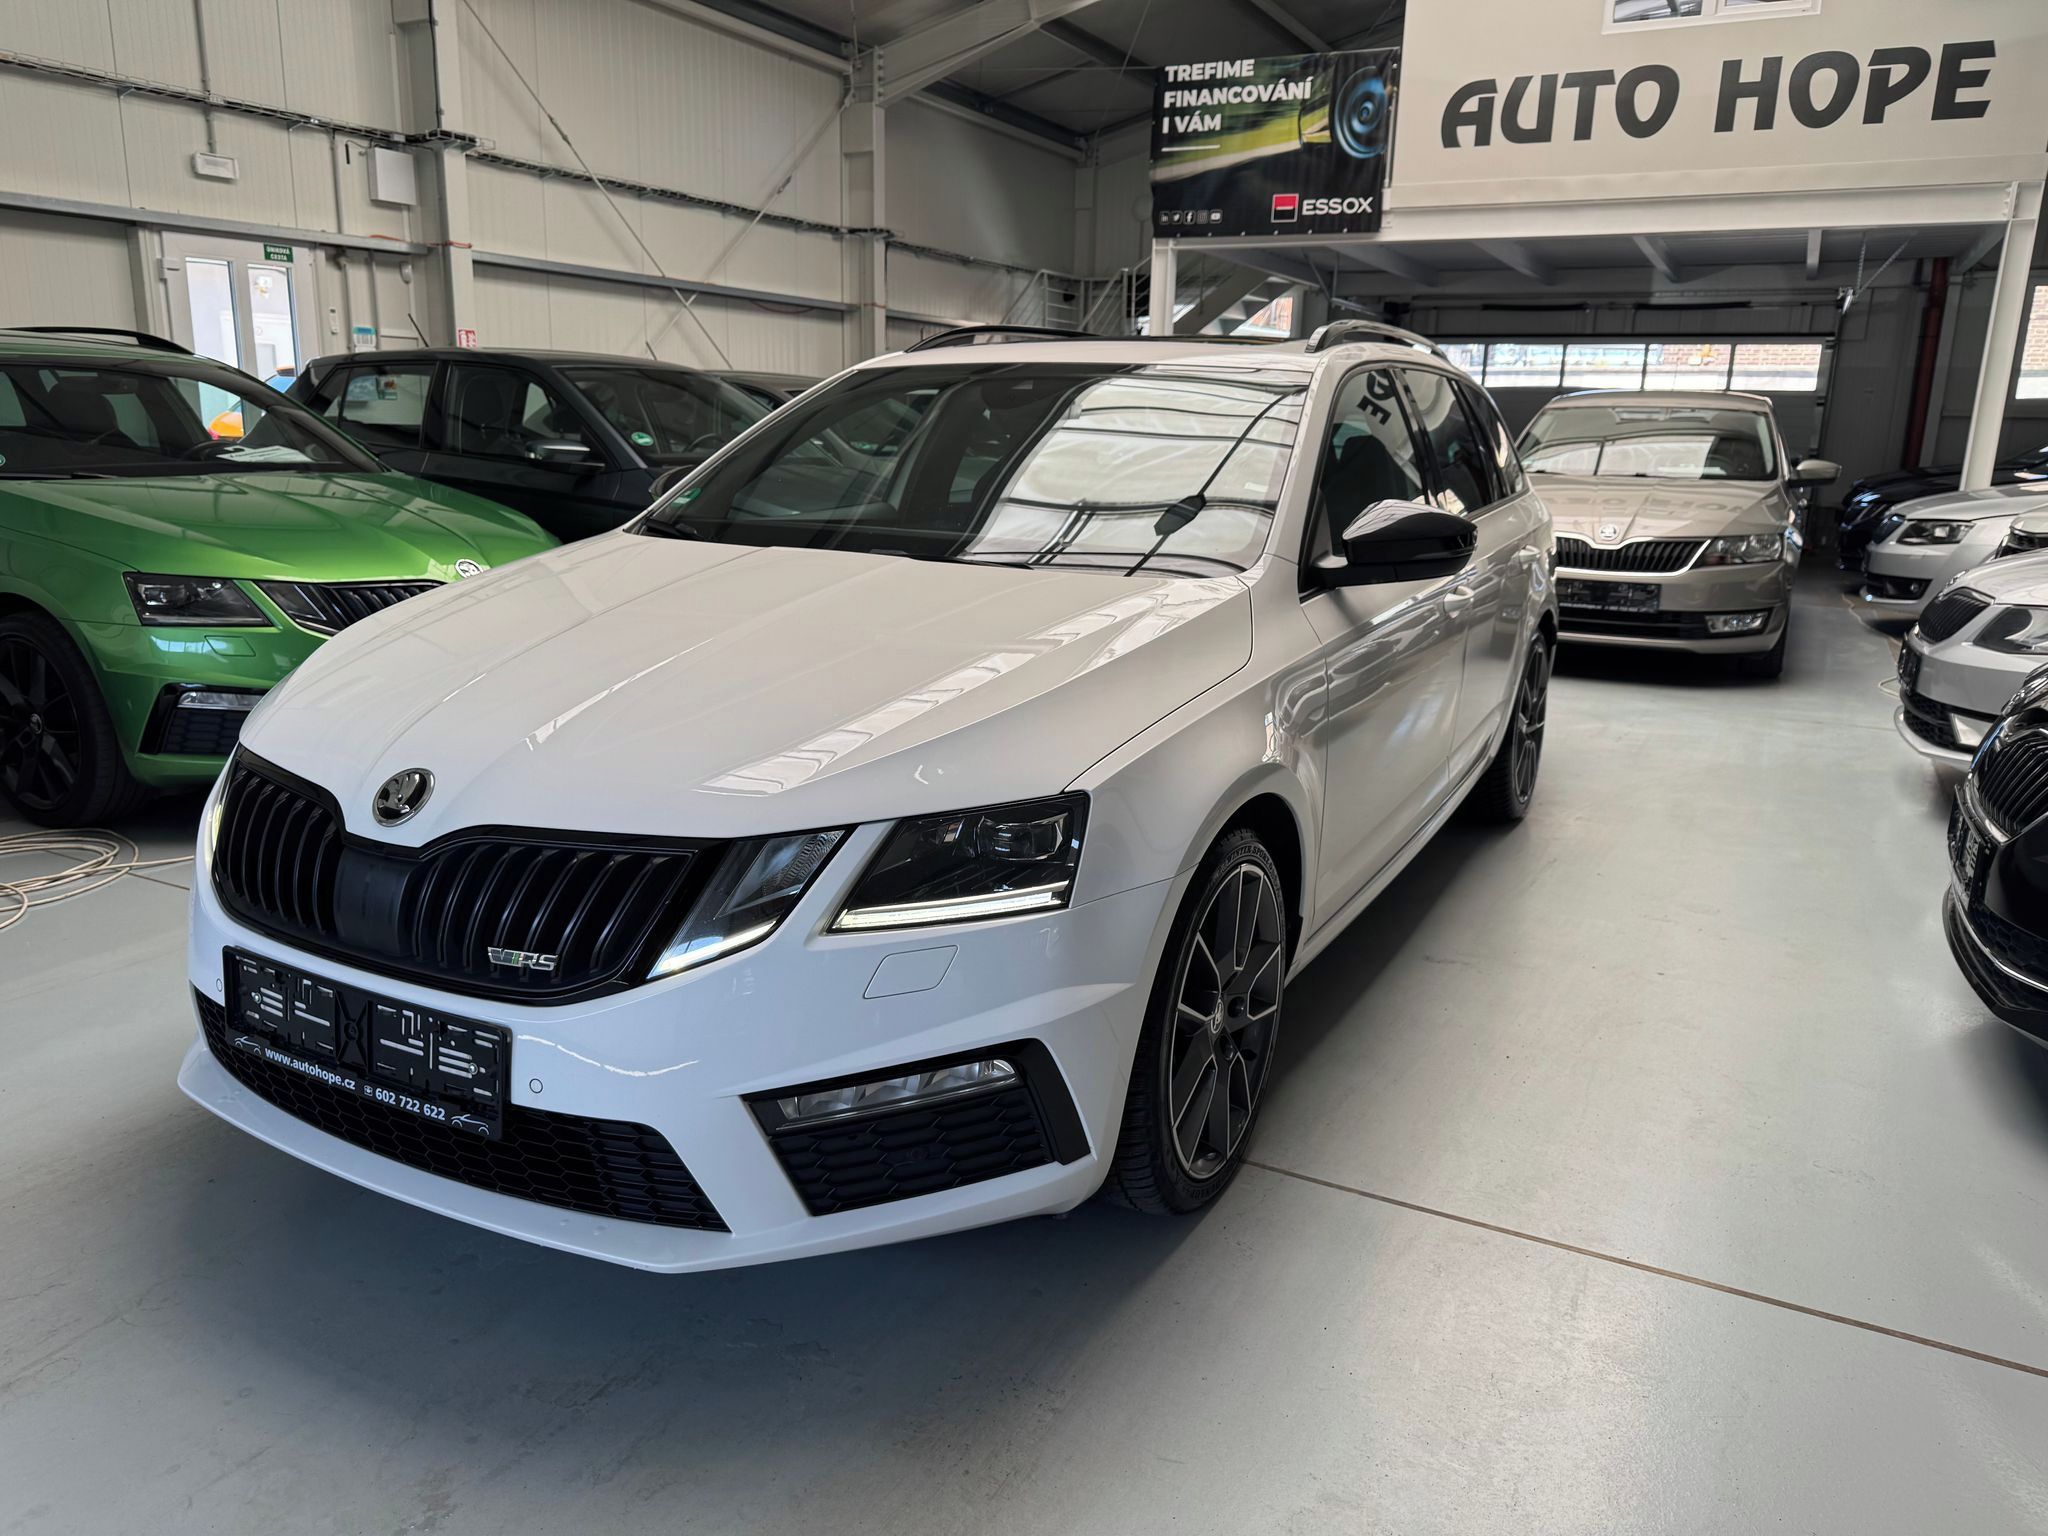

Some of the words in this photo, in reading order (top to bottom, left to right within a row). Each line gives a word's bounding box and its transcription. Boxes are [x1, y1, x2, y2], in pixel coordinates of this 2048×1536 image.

[1165, 59, 1255, 83] TREFIME
[1163, 76, 1314, 108] FINANCOVÁNÍ
[1441, 63, 1680, 148] AUTO
[1714, 39, 1996, 134] HOPE
[1161, 115, 1170, 134] I
[1174, 110, 1222, 133] VÁM
[1302, 197, 1374, 216] ESSOX
[265, 1047, 356, 1091] www.autohope.cz
[375, 1087, 397, 1105] 602
[399, 1095, 421, 1113] 722
[423, 1103, 446, 1121] 622
